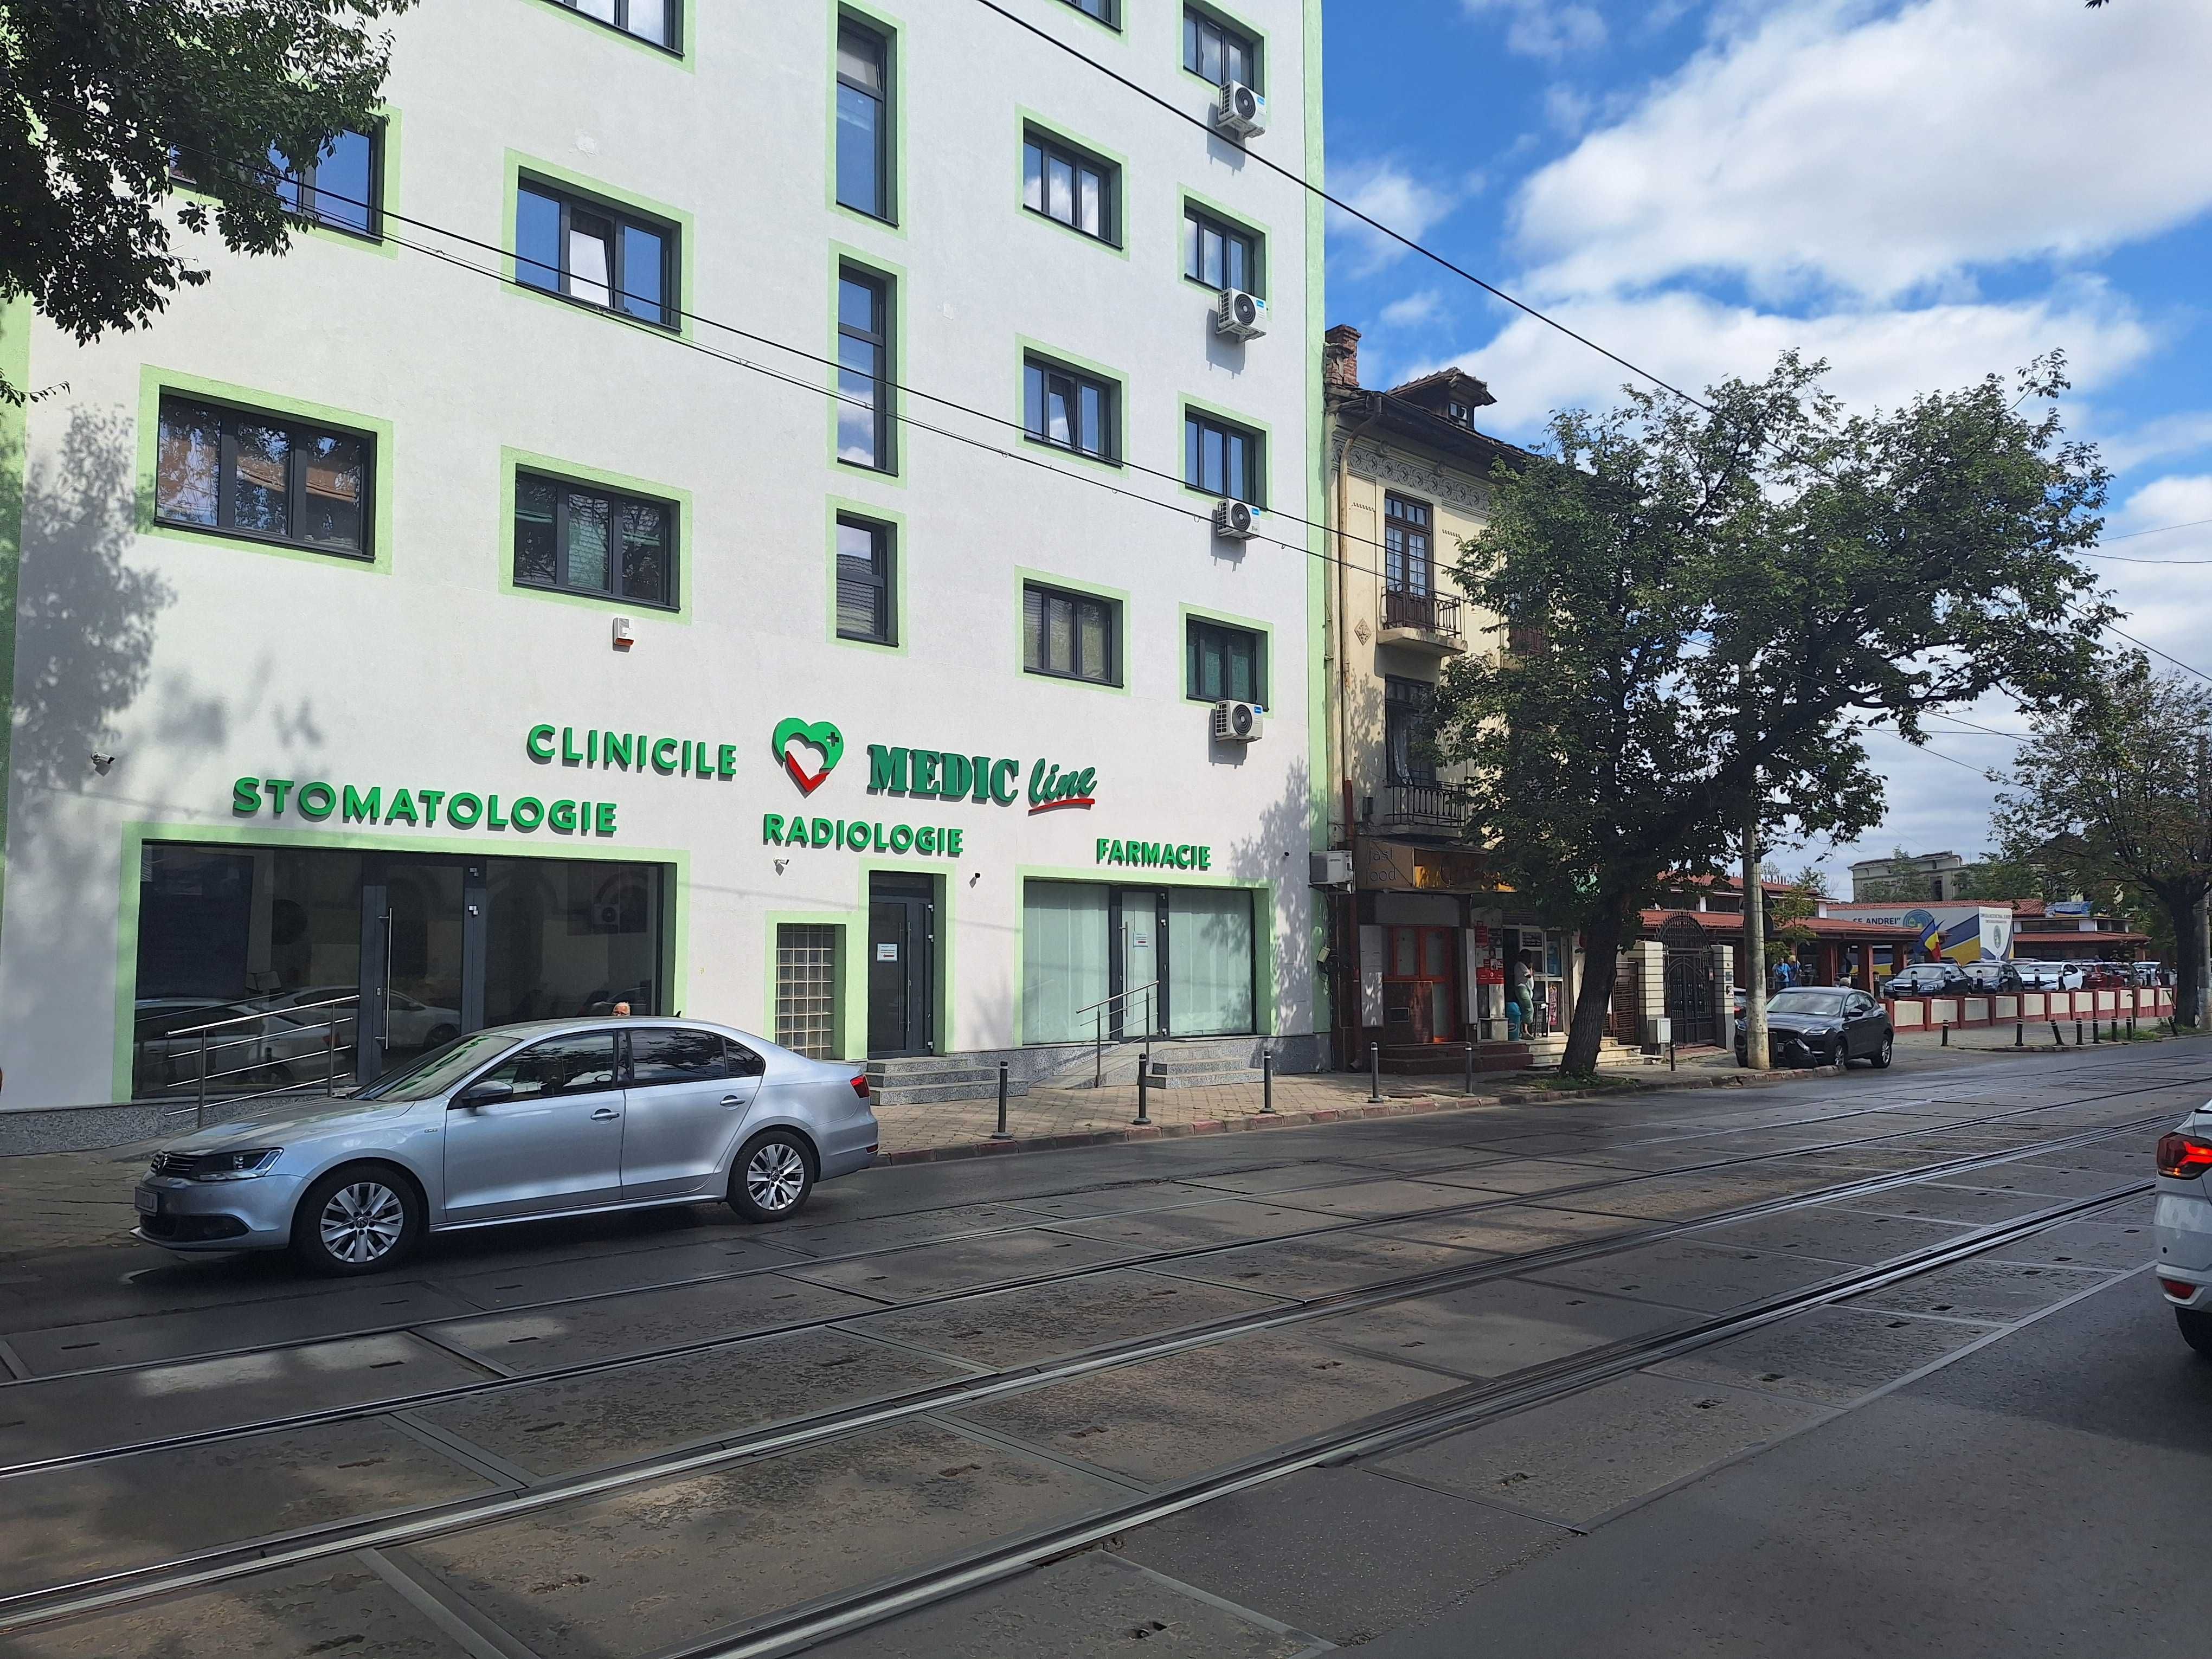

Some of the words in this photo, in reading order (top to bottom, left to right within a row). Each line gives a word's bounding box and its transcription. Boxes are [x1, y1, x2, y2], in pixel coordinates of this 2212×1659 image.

[527, 724, 736, 775] CLINICILE
[867, 744, 1019, 803] MEDIC
[1028, 758, 1097, 803] line
[233, 777, 617, 833] STOMATOLOGIE
[763, 814, 963, 854] RADIOLOGIE
[1096, 838, 1211, 867] FARMACIE
